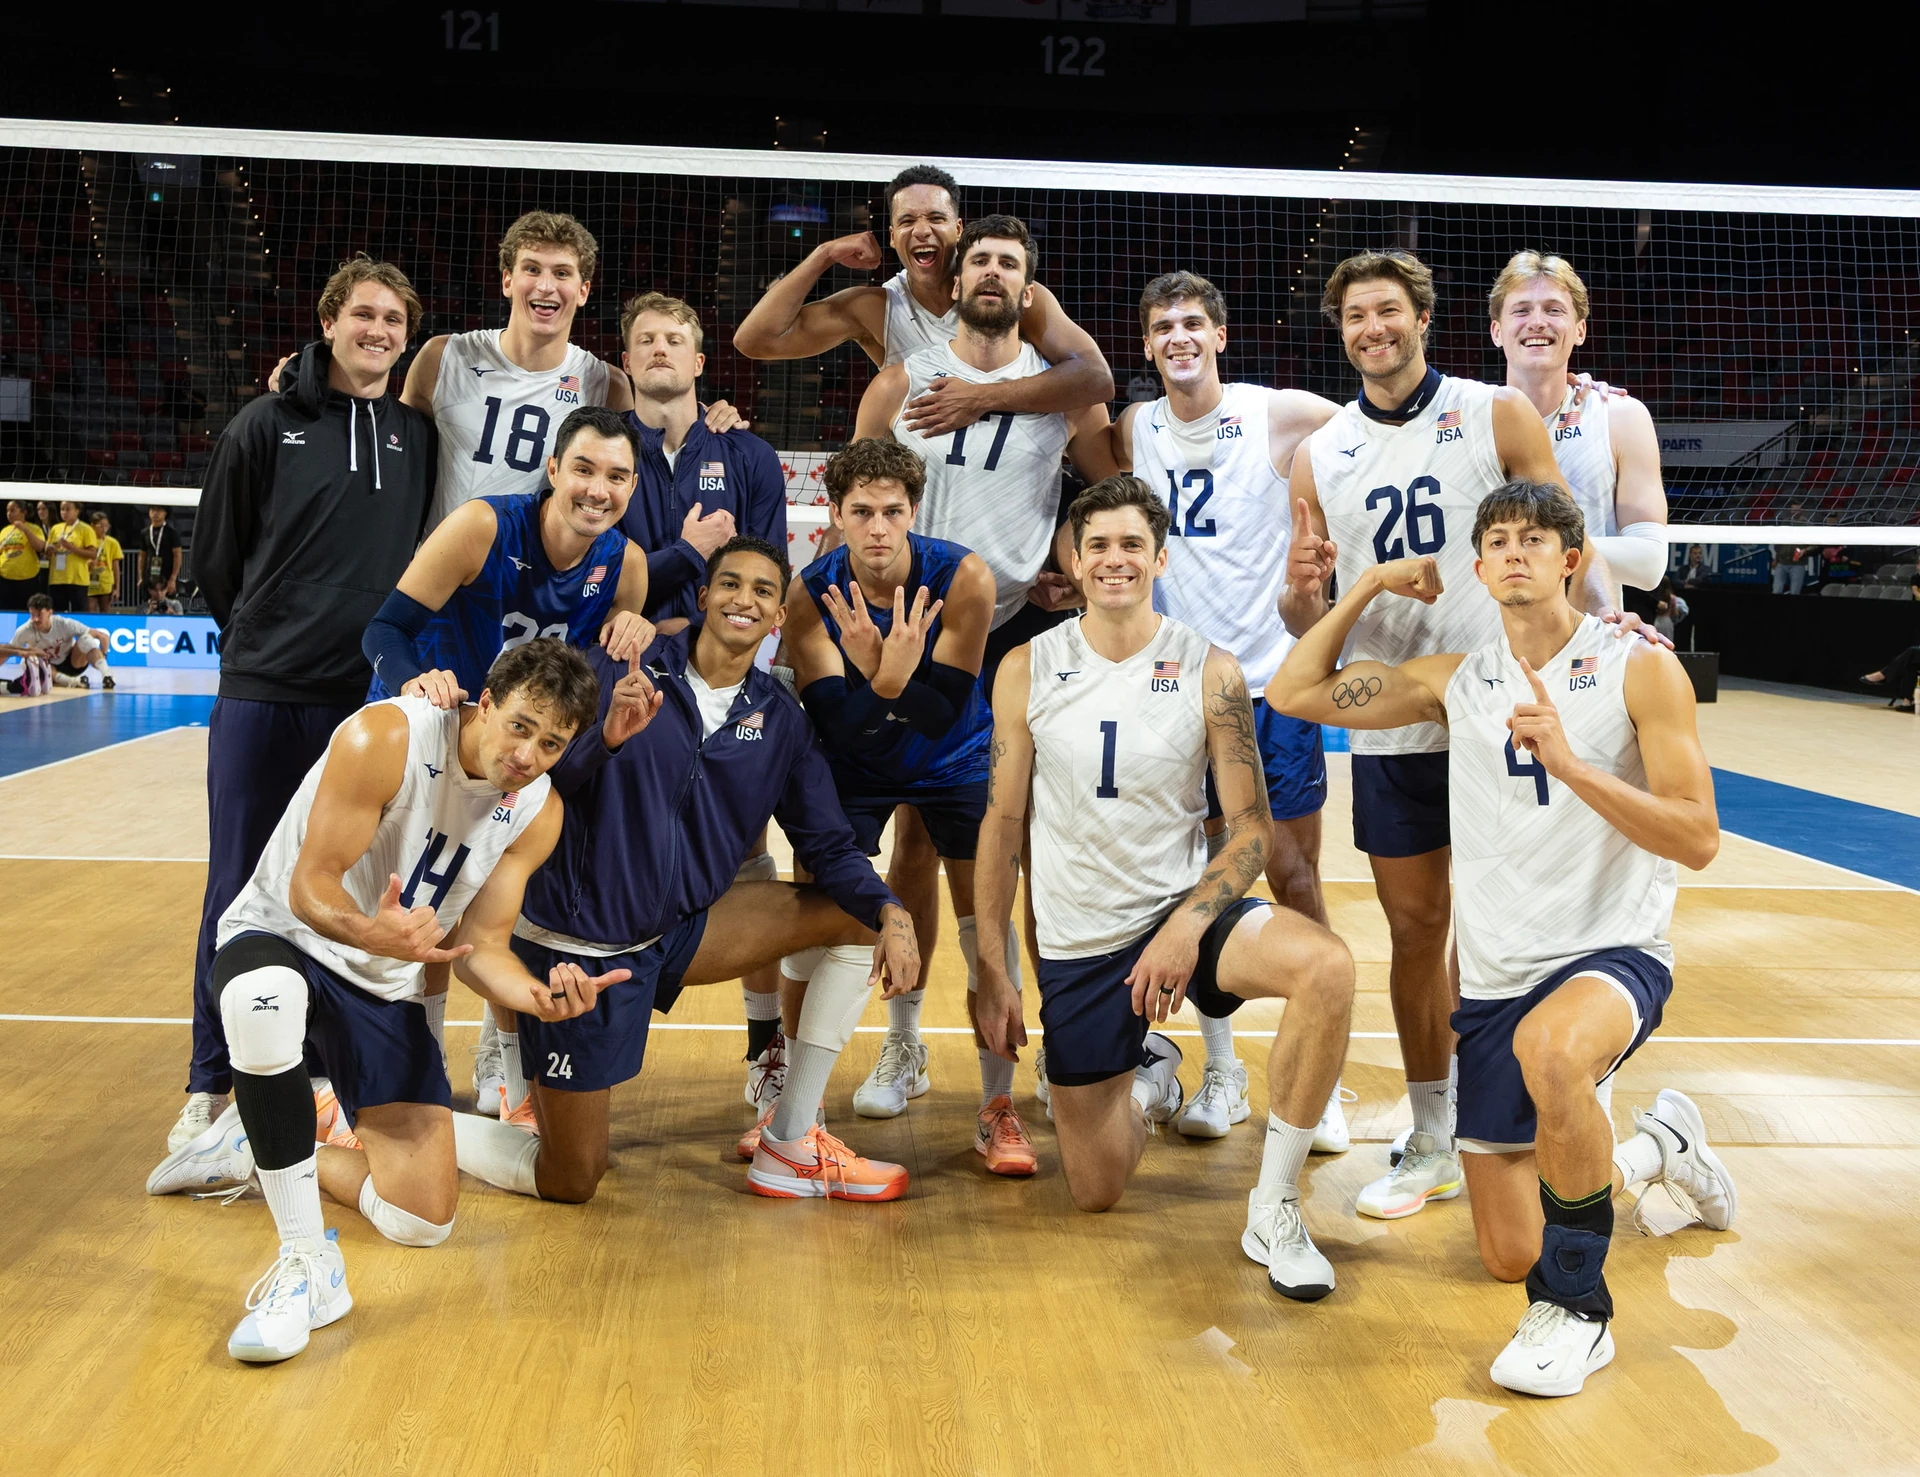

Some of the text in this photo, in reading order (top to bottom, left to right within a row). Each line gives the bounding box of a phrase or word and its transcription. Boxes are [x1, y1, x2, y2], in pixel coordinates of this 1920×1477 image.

[441, 10, 500, 52] 121
[1040, 36, 1106, 77] 122
[555, 388, 579, 405] USA
[473, 396, 551, 473] 18
[945, 409, 1016, 472] 17
[1216, 425, 1243, 440] USA
[1436, 426, 1464, 444] USA
[1555, 425, 1582, 442] USA
[1662, 438, 1703, 452] PARTS
[699, 476, 725, 491] USA
[1168, 469, 1217, 537] 12
[1365, 474, 1446, 564] 26
[1151, 678, 1179, 693] USA
[1569, 675, 1597, 692] USA
[736, 724, 763, 741] USA
[1096, 721, 1119, 798] 1
[492, 806, 512, 824] SA
[399, 827, 471, 914] 14
[546, 1051, 573, 1080] 24
